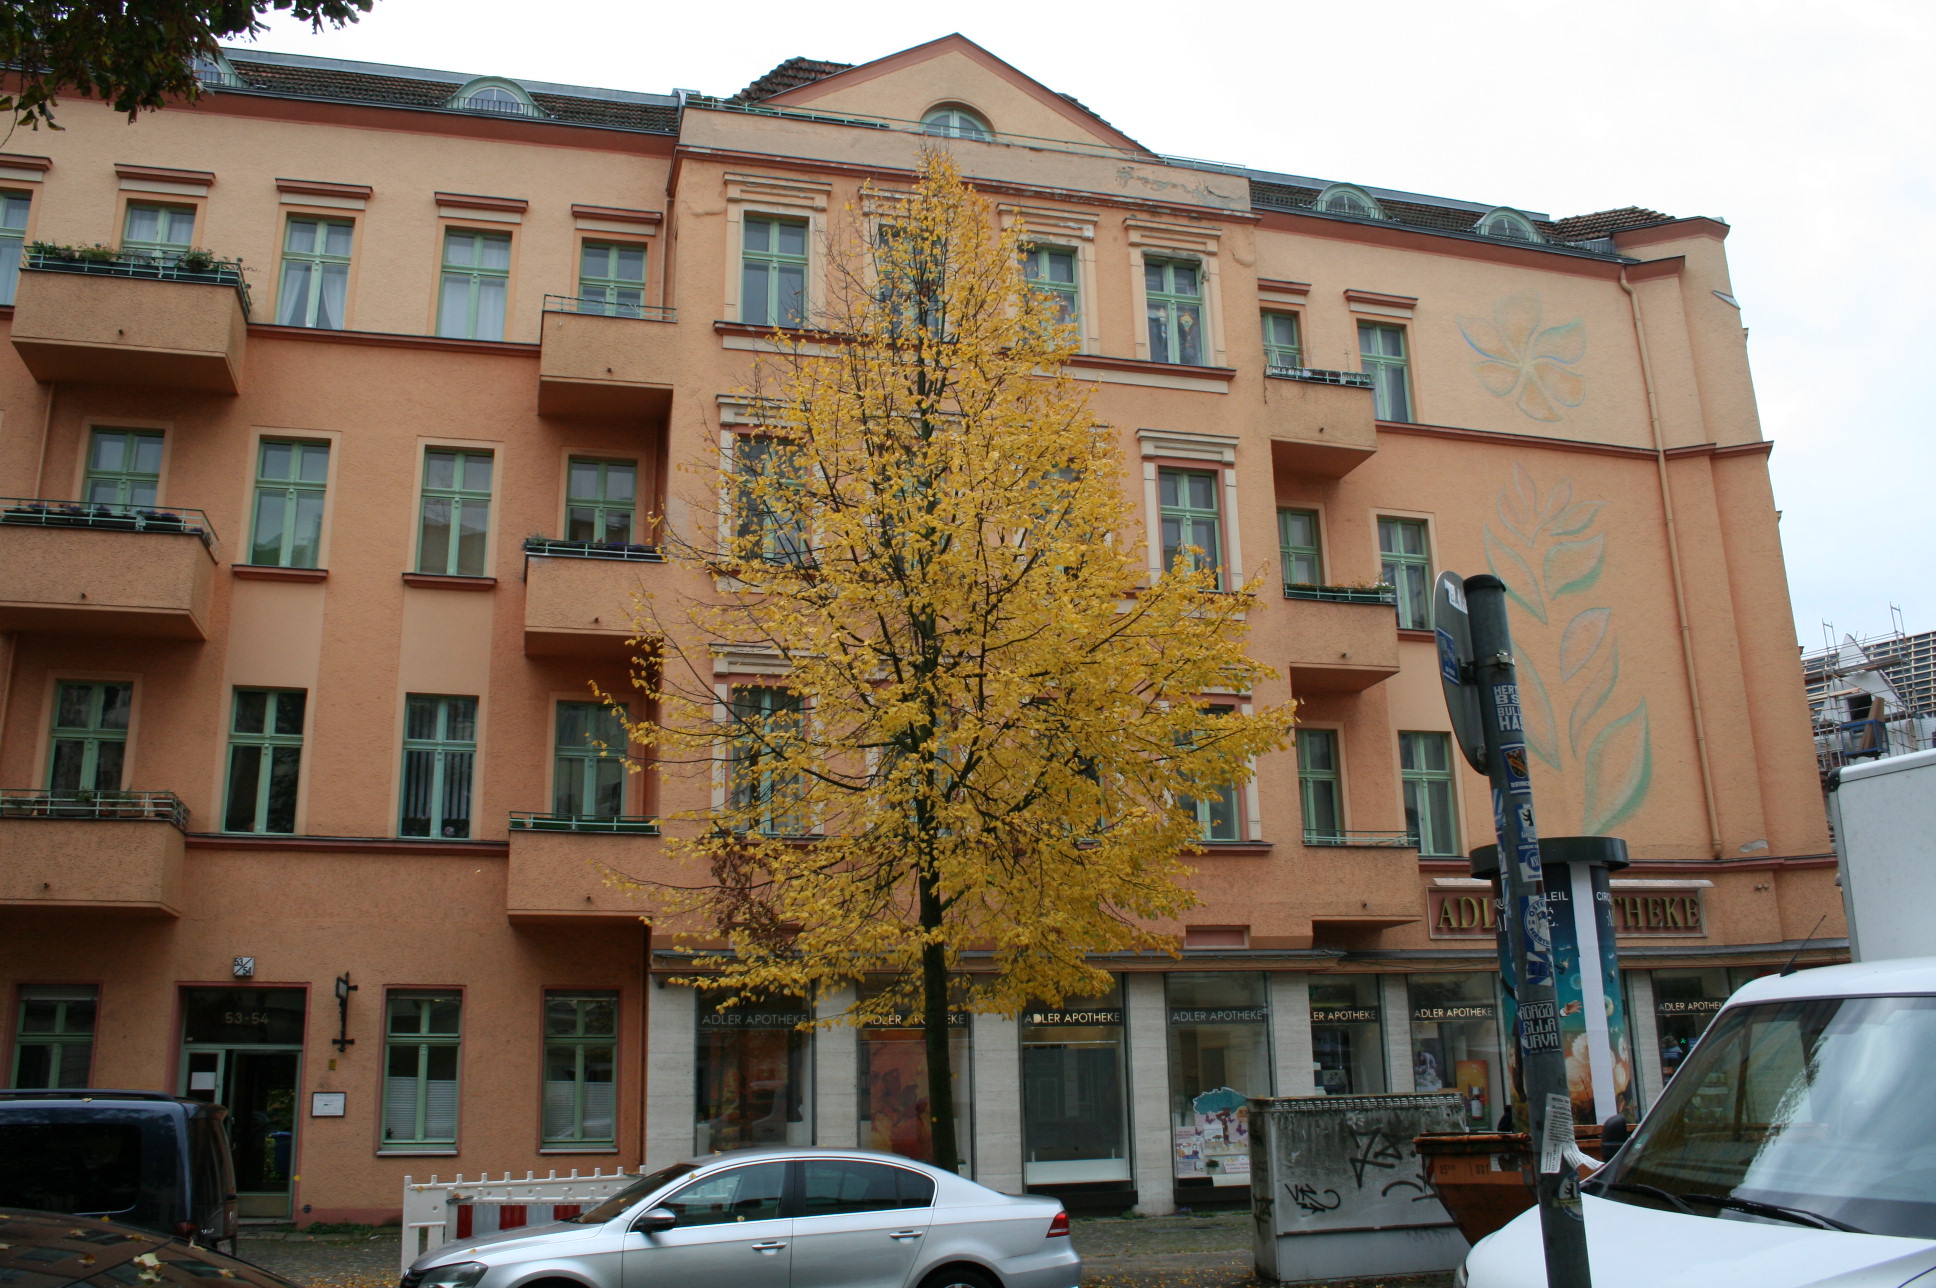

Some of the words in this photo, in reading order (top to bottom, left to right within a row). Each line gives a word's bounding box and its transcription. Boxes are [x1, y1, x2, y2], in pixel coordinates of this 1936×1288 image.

[1544, 891, 1569, 902] LEIL
[1437, 896, 1496, 929] ADL
[234, 958, 244, 967] 53
[242, 966, 252, 976] 54
[1658, 1002, 1686, 1012] ADLER
[1687, 1001, 1724, 1011] APOTHEK
[225, 1011, 270, 1025] 53-54
[1025, 1013, 1061, 1024] ADLER
[1063, 1012, 1120, 1023] APOTHEKE
[1172, 1011, 1206, 1022] ADLER
[1209, 1010, 1263, 1021] APOTHEKE
[1327, 1010, 1376, 1020] APOTHEKE
[1414, 1008, 1444, 1018] ADLER
[1446, 1007, 1493, 1017] APOTHEKE
[702, 1015, 741, 1025] ADLER
[745, 1014, 807, 1025] APOTHEKE
[1523, 1018, 1557, 1035] ELLA
